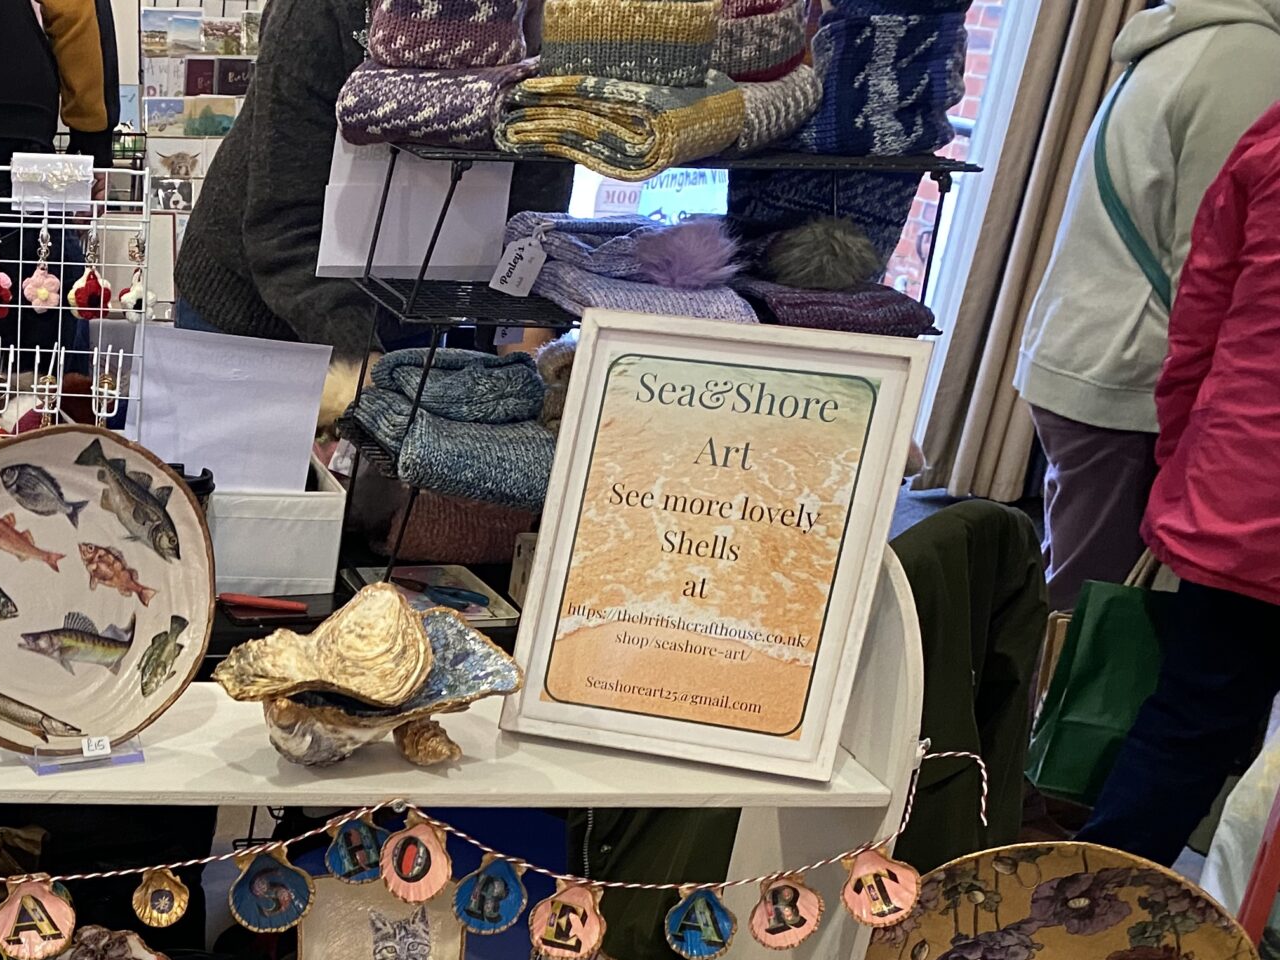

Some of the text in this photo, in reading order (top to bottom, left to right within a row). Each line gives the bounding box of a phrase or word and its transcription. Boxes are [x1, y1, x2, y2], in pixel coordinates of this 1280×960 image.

[602, 190, 641, 205] MOO
[500, 246, 525, 285] Penley's
[635, 372, 839, 423] Sea&Shore
[693, 436, 755, 471] Art
[609, 482, 822, 535] See more lovely
[661, 530, 741, 562] Shells
[682, 577, 708, 600] at
[567, 601, 813, 649] https://thebritishcrafthouse.co.uk/
[614, 631, 753, 663] shop/seashore-art/
[585, 675, 763, 714] Seashoreart25@gmail.com
